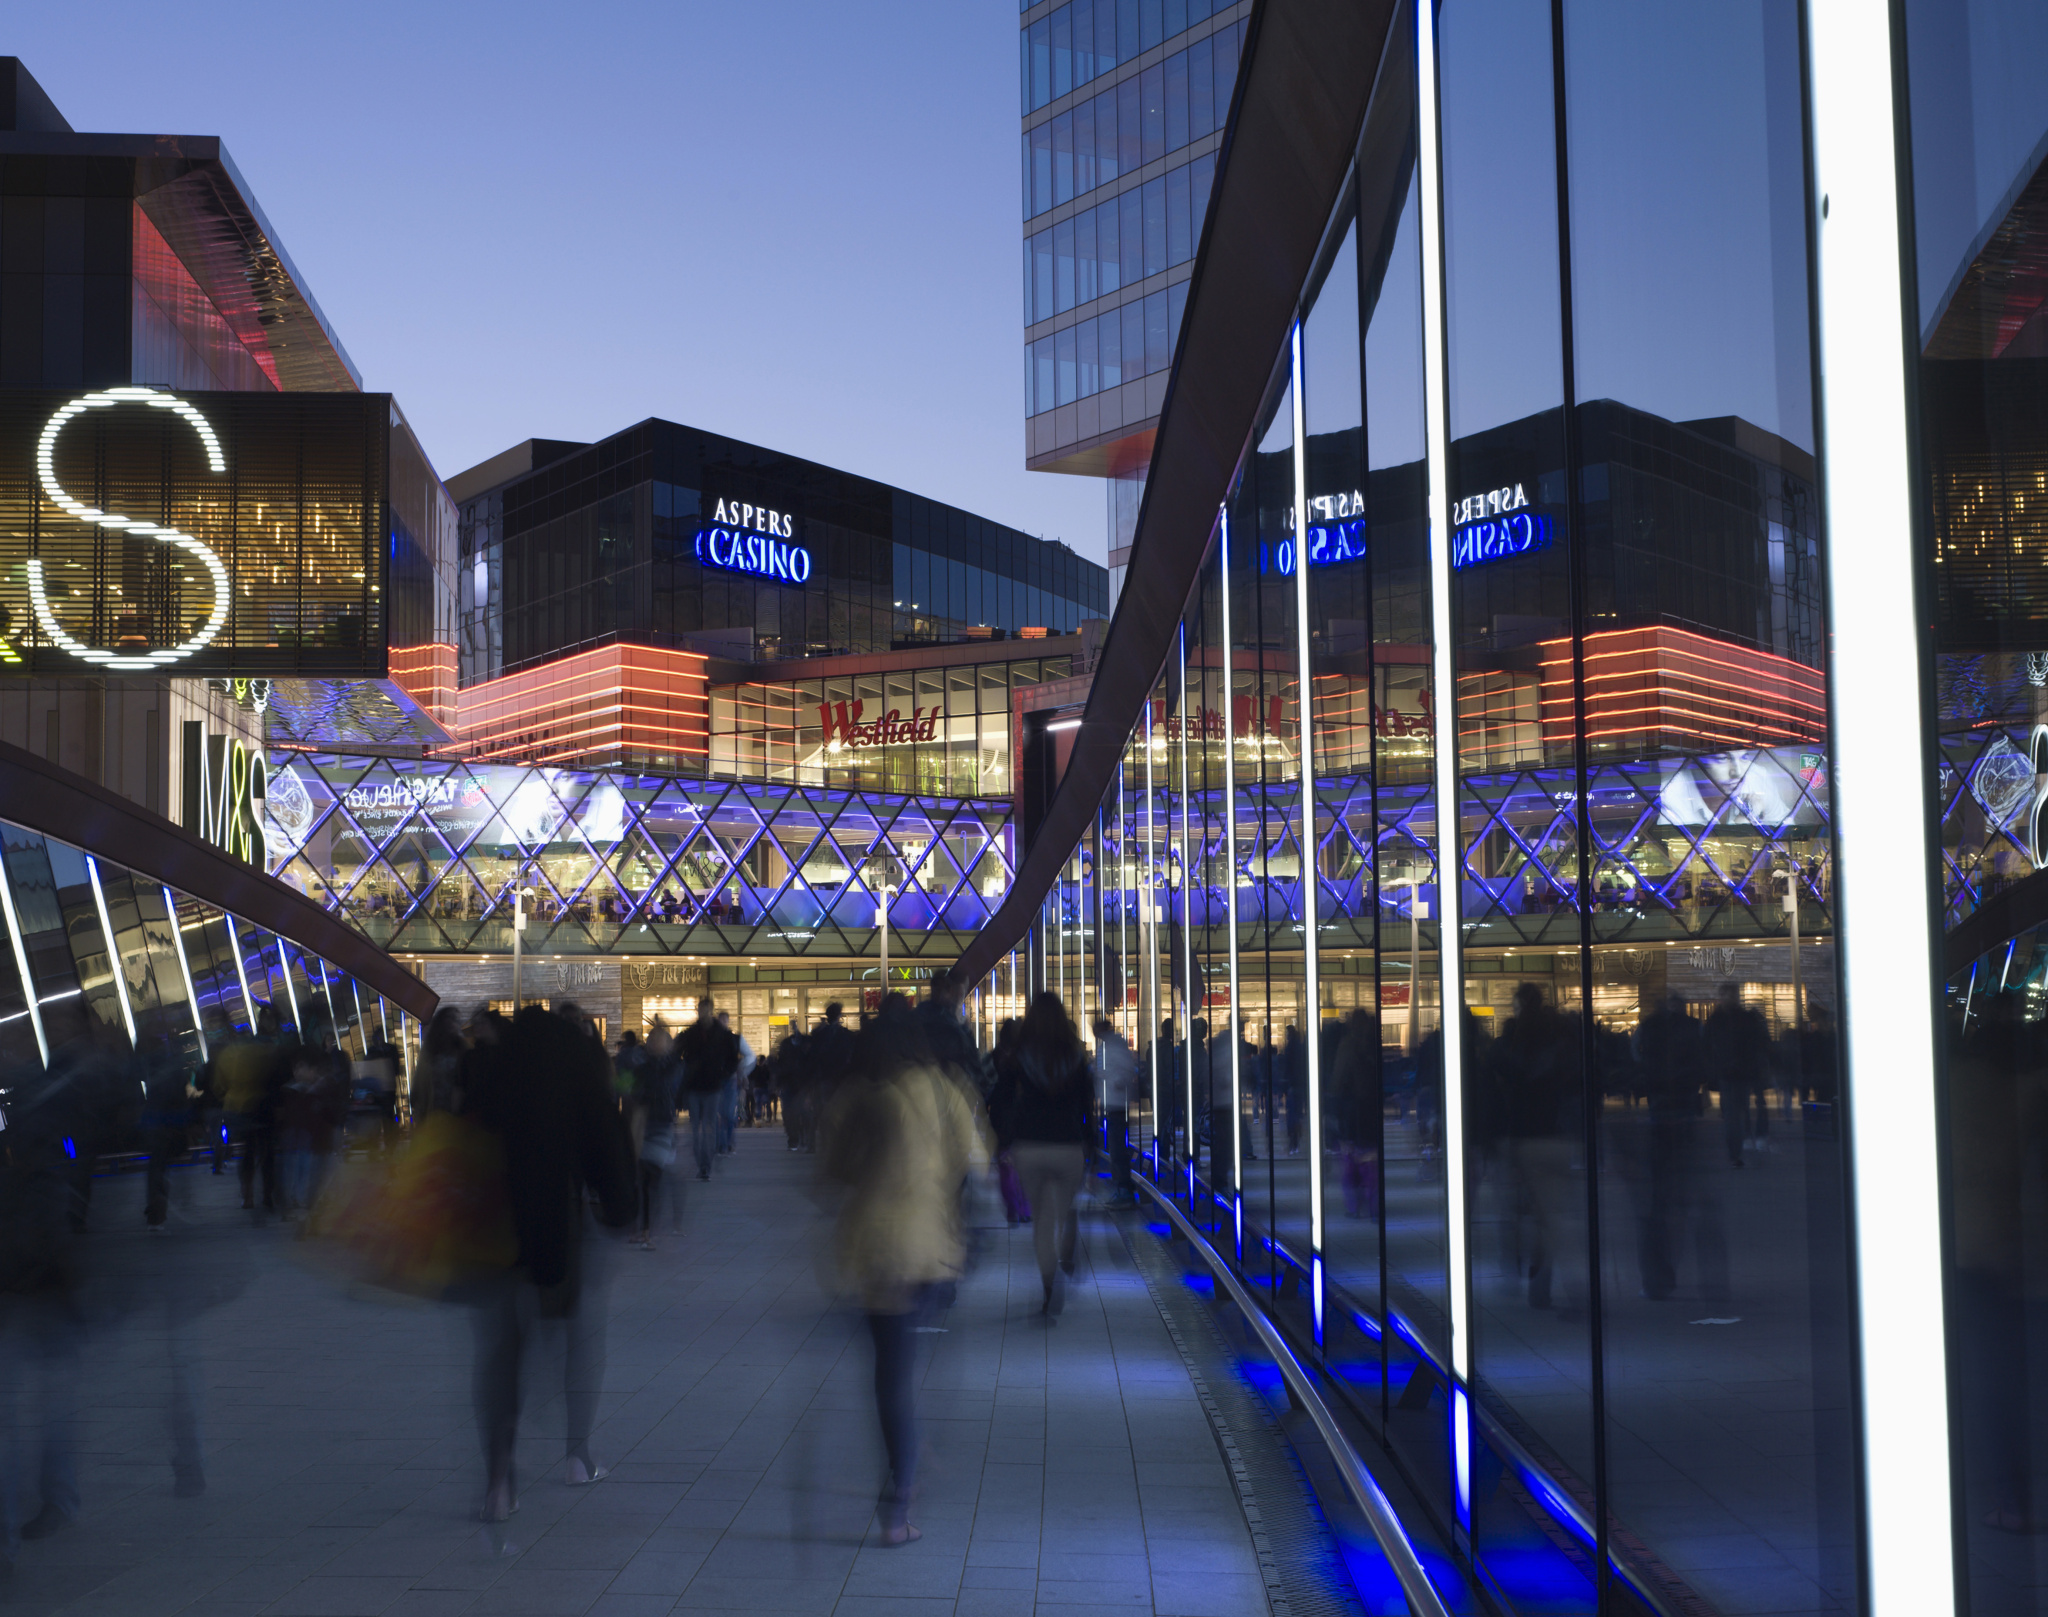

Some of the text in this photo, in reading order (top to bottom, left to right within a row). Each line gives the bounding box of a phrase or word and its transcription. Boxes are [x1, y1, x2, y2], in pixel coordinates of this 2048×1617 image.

[0, 387, 230, 669] S
[713, 497, 793, 538] ASPERS
[708, 527, 812, 583] CASINO
[816, 698, 943, 749] Westfield
[684, 856, 726, 878] M&S
